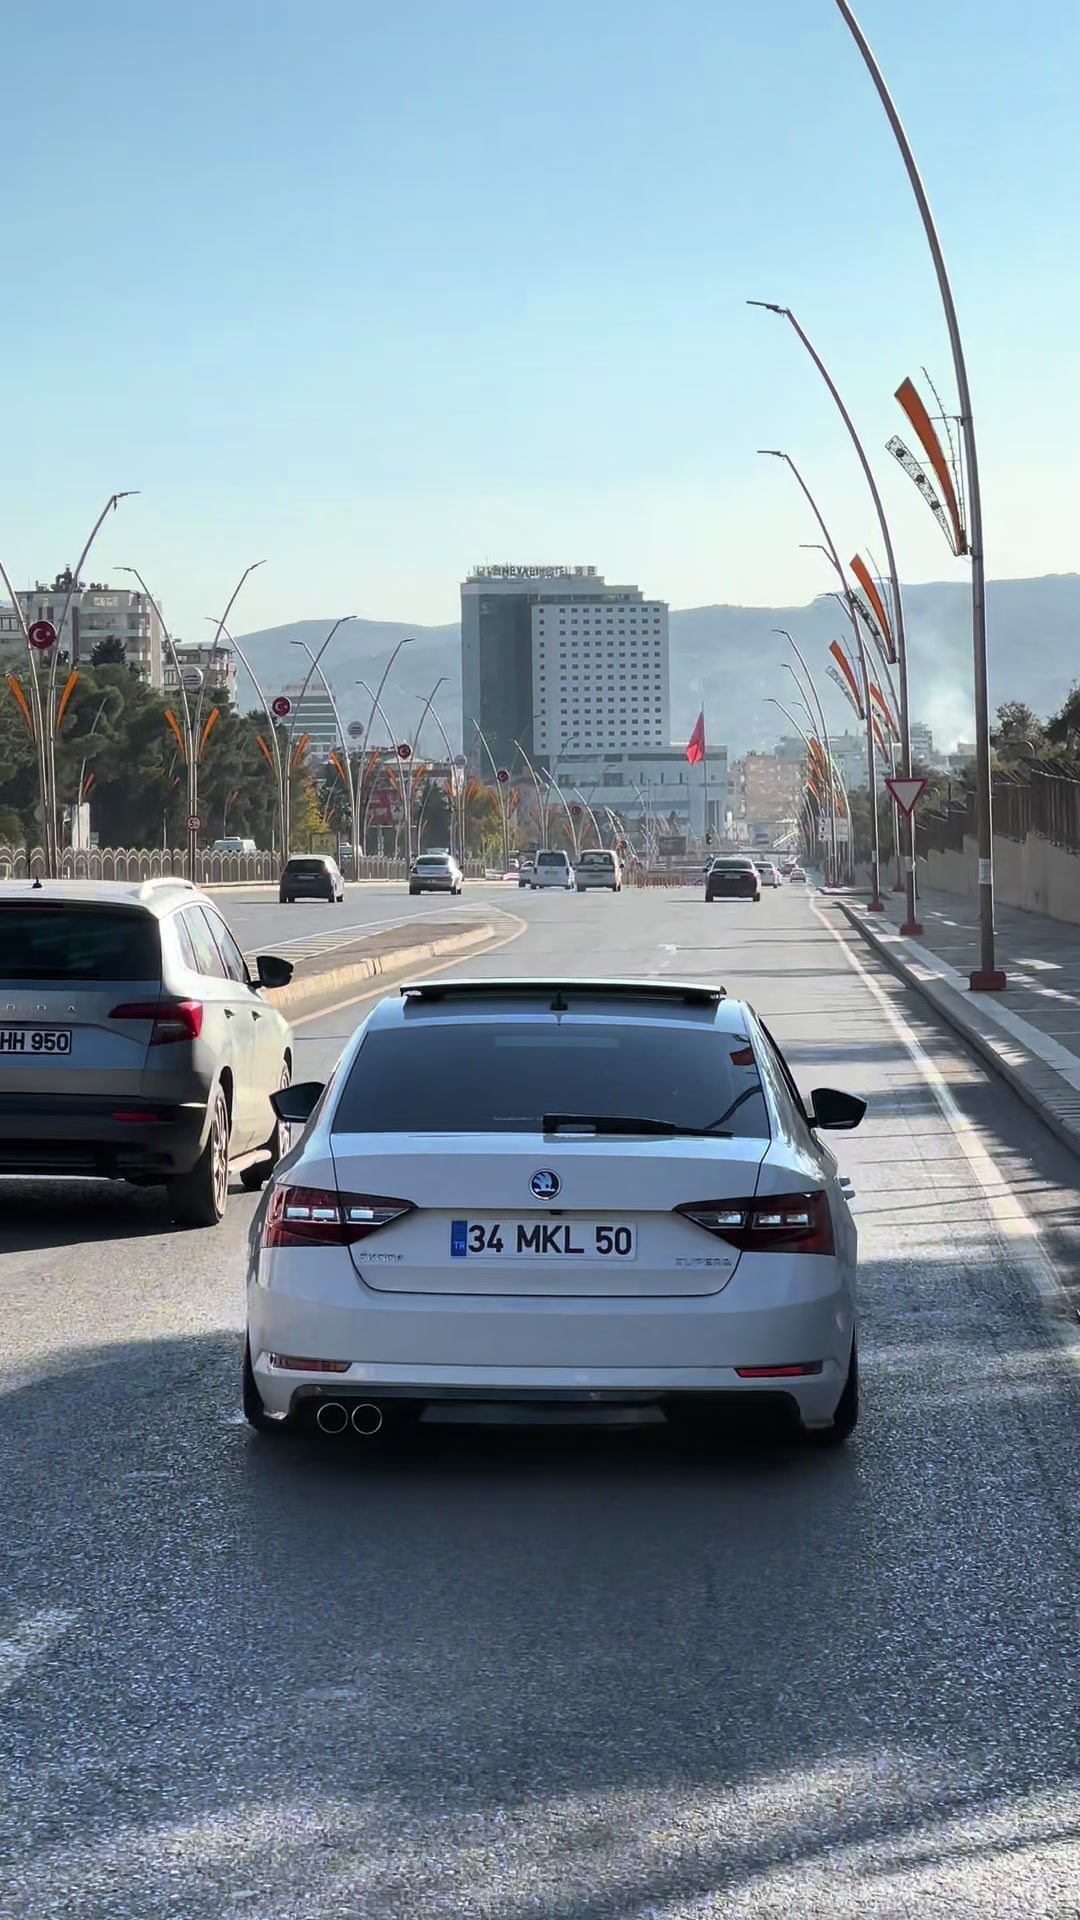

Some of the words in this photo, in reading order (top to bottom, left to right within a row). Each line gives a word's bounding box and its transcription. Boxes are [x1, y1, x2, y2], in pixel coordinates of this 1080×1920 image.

[31, 1032, 69, 1051] 950
[453, 1241, 465, 1250] TR
[468, 1224, 504, 1253] 34
[516, 1225, 585, 1254] MKL
[595, 1226, 632, 1255] 50
